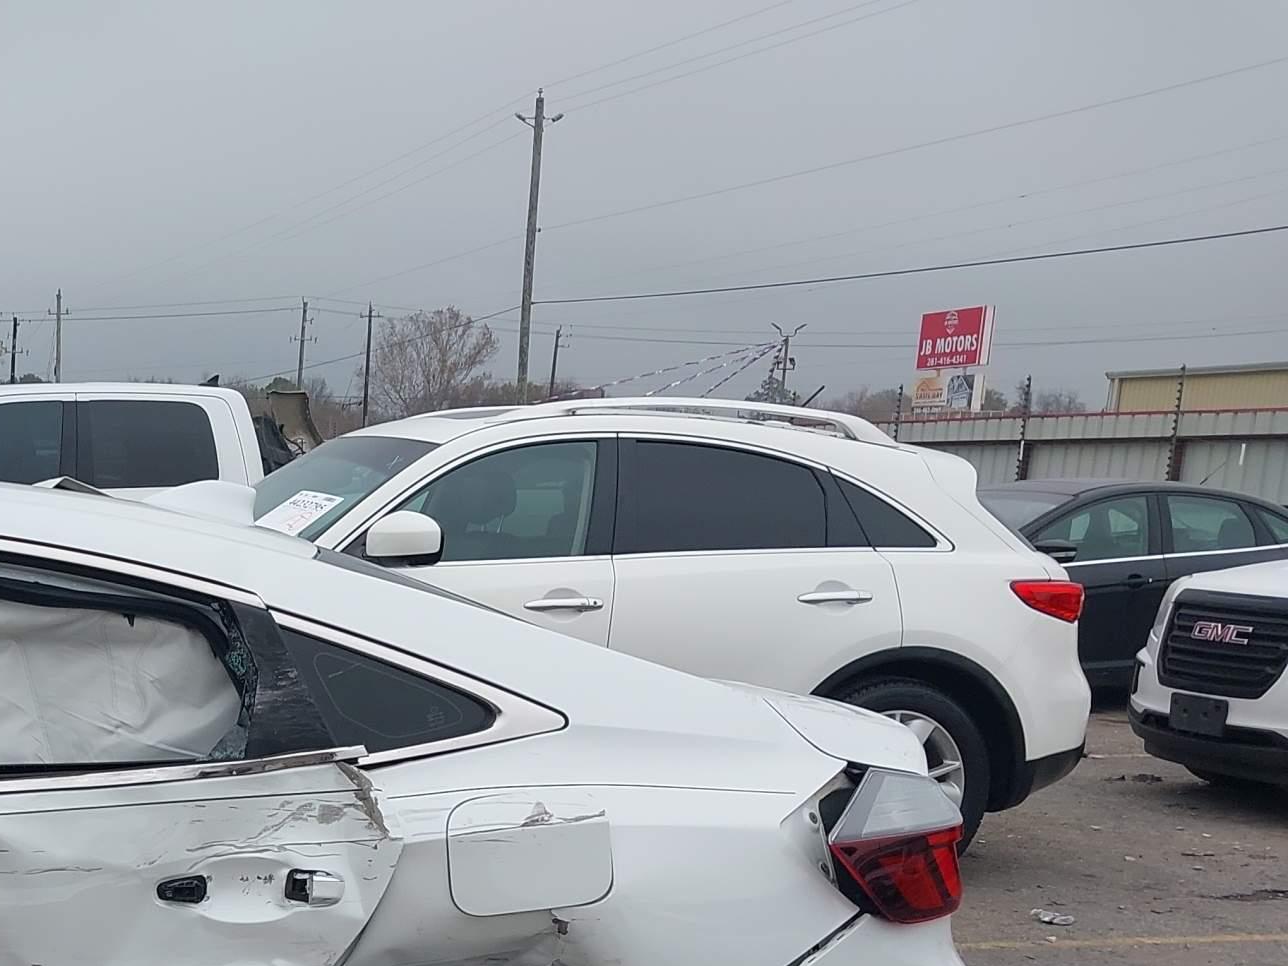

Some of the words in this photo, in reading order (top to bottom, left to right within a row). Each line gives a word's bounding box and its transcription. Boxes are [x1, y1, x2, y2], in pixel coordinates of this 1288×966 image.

[920, 339, 932, 355] JB
[935, 334, 977, 354] MOTORS
[1191, 621, 1253, 645] GMC
